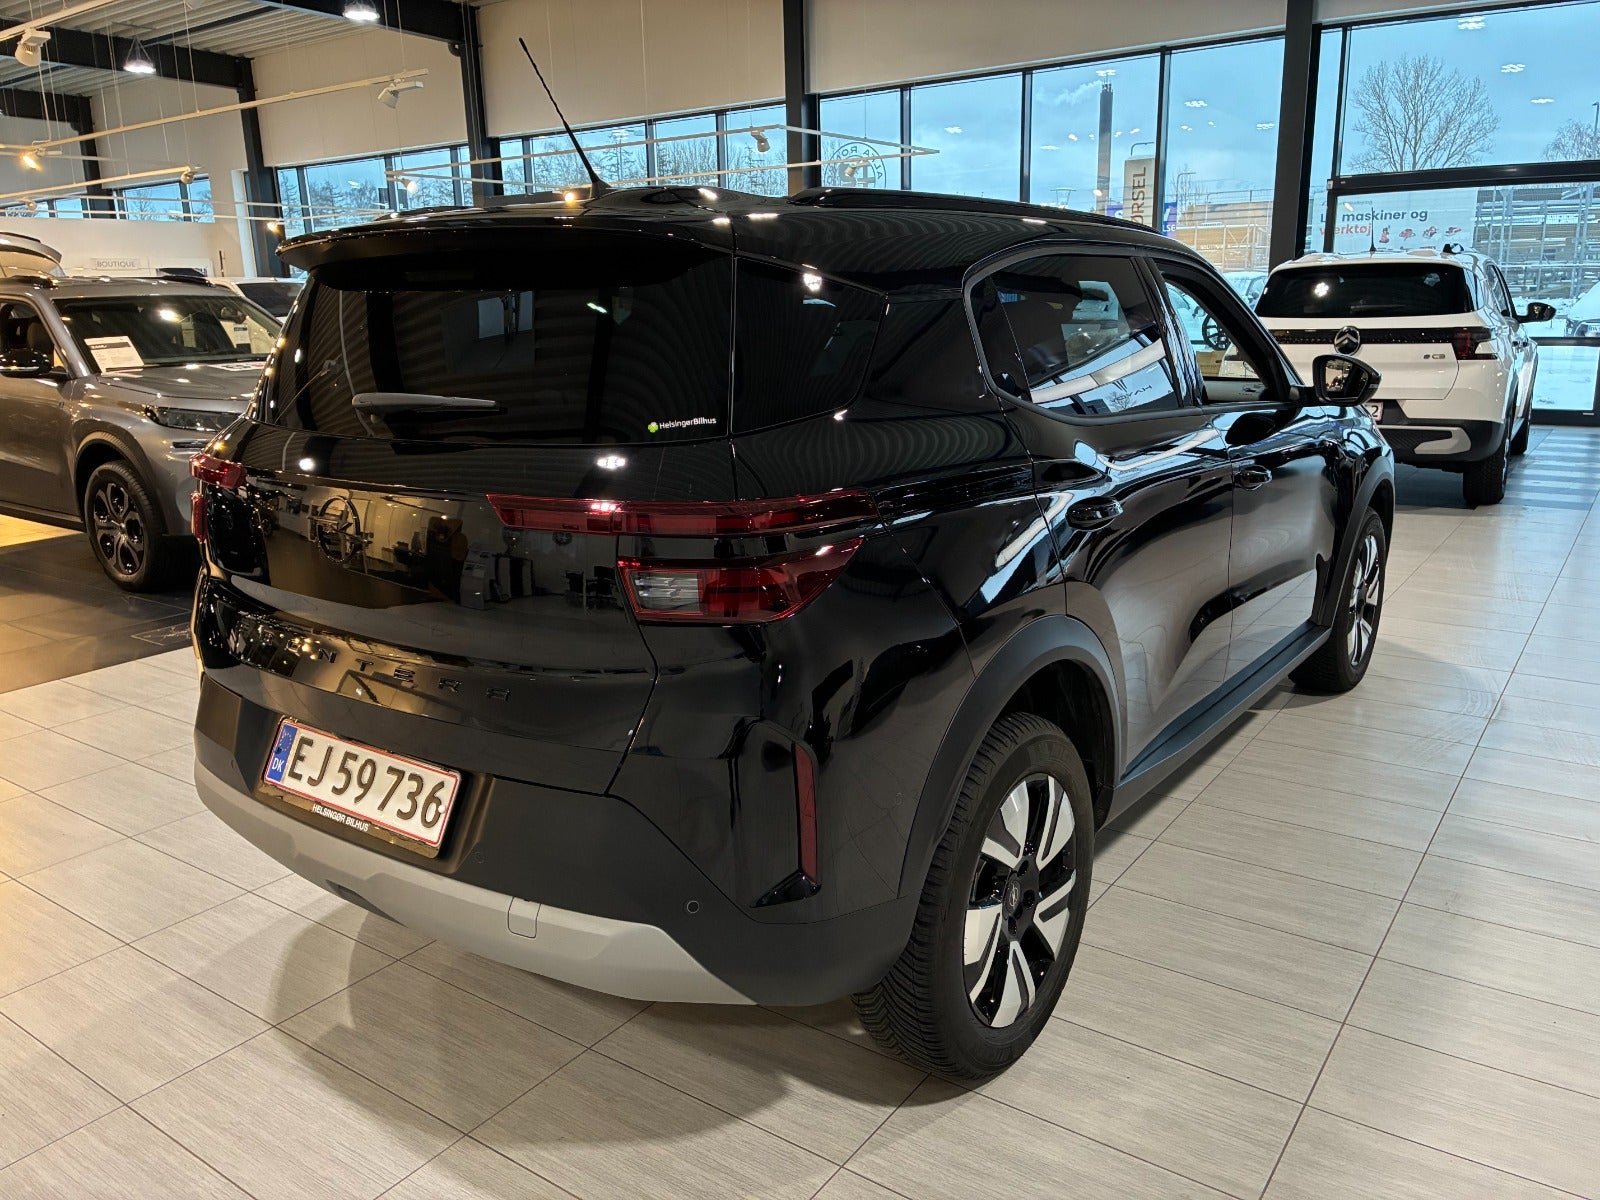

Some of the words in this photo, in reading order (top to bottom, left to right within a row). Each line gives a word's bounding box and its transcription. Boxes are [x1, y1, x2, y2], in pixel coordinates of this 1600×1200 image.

[1342, 209, 1406, 222] maskiner
[1411, 210, 1428, 222] og
[96, 260, 136, 269] BOUTIQUE
[271, 758, 285, 772] DK
[312, 803, 346, 823] HELSINGØR
[345, 816, 369, 832] BILHUS
